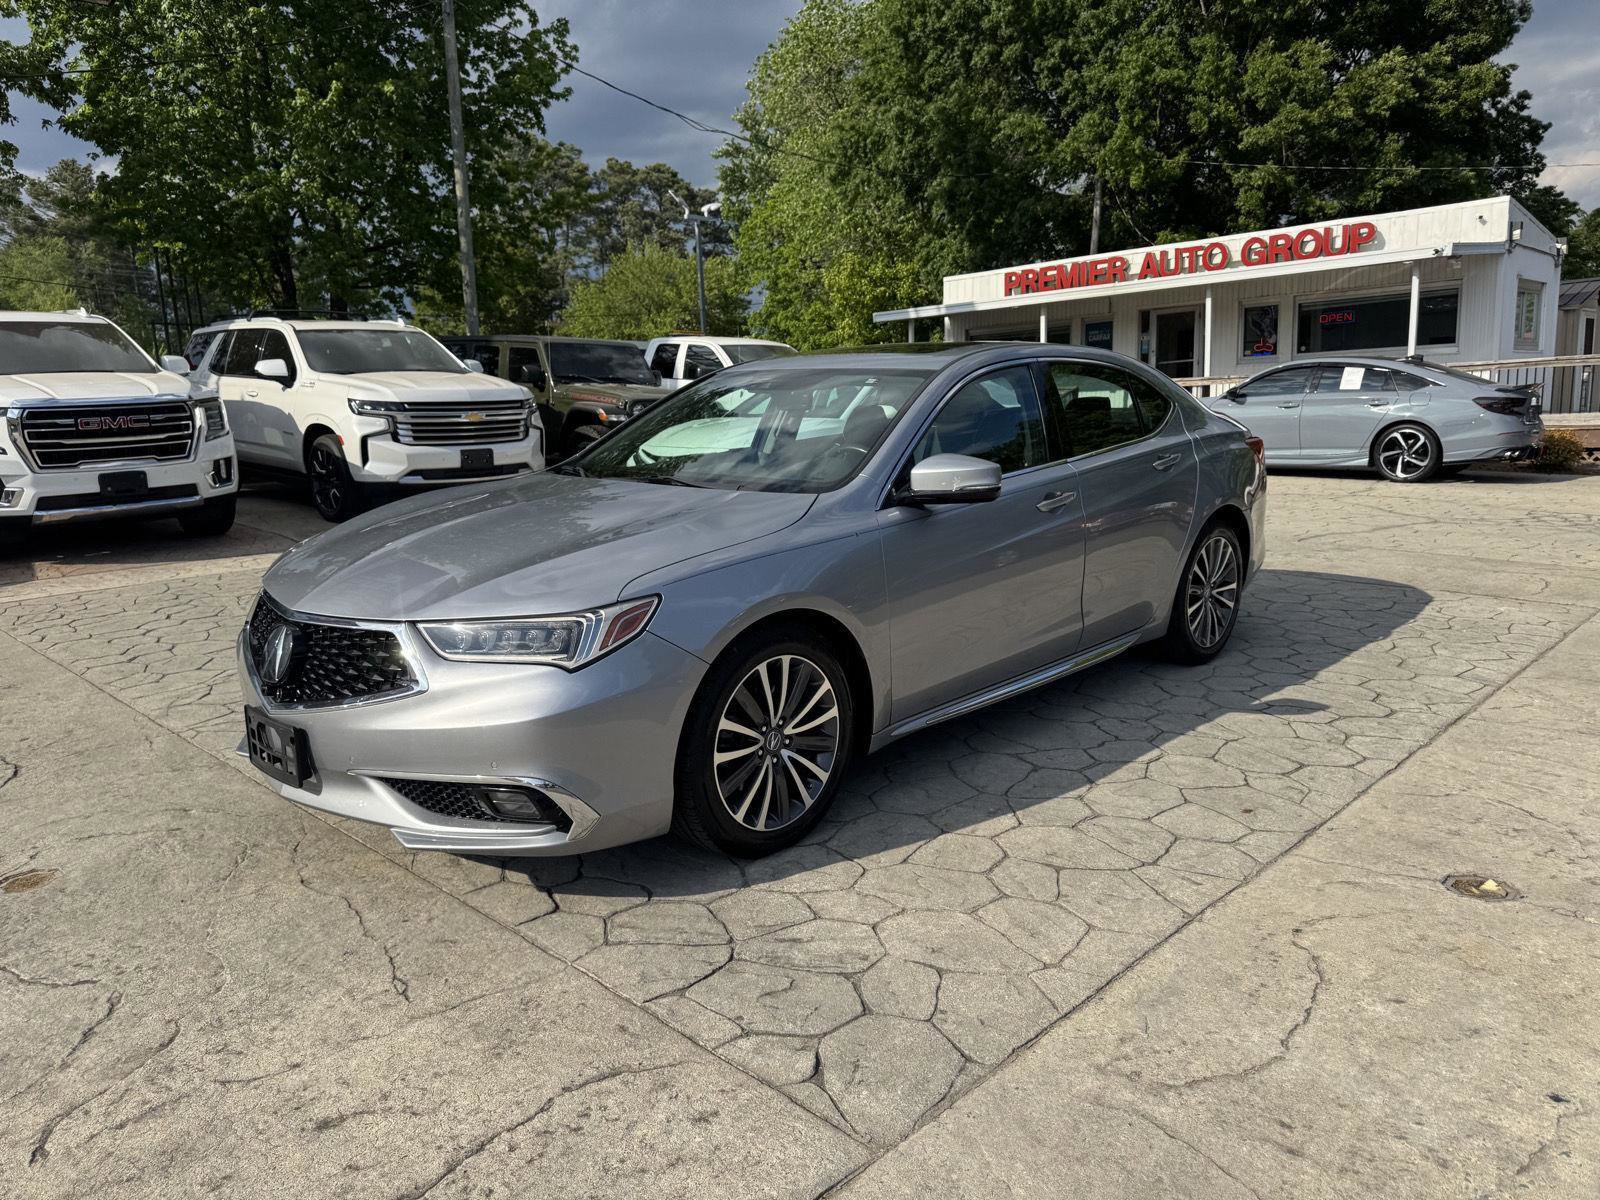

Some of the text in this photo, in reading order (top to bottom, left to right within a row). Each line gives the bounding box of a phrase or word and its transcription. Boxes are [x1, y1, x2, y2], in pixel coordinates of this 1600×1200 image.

[1004, 222, 1377, 297] PREMIER AUTO GROUP
[1319, 312, 1353, 324] OPEN
[77, 414, 150, 430] GMC
